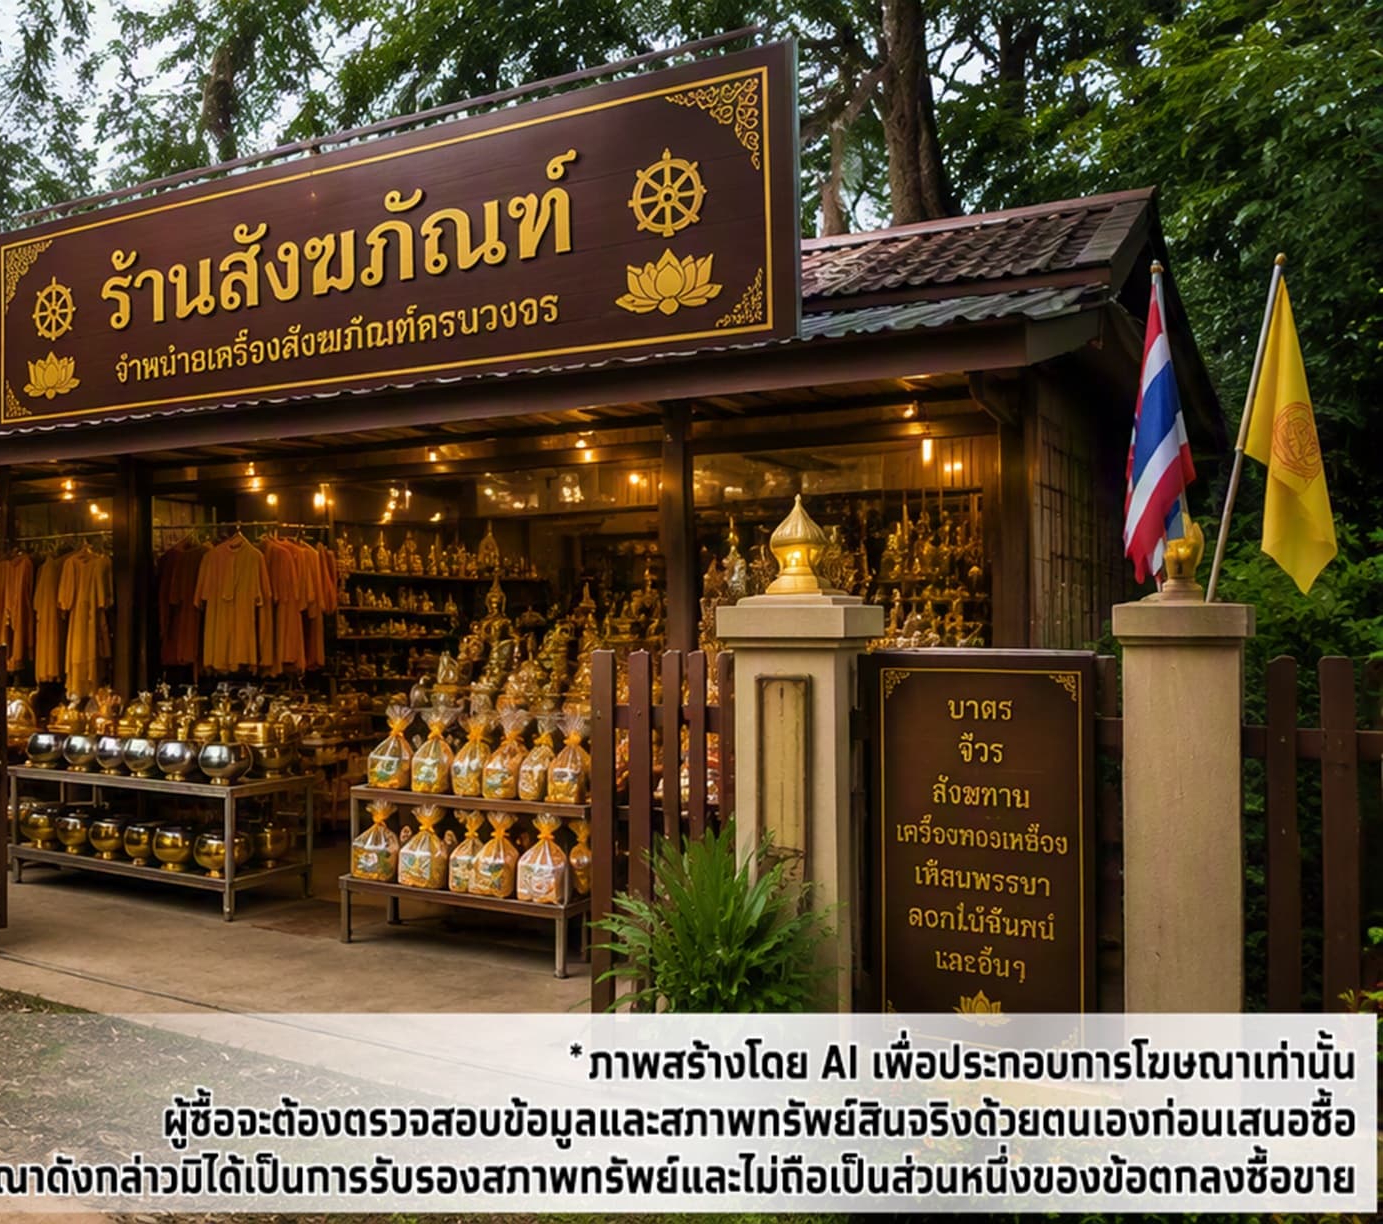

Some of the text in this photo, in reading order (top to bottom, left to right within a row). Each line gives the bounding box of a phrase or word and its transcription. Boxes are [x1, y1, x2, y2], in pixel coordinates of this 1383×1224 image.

[101, 149, 577, 330] ร้านสังฆภัณฑ์
[947, 699, 1013, 720] บาตร
